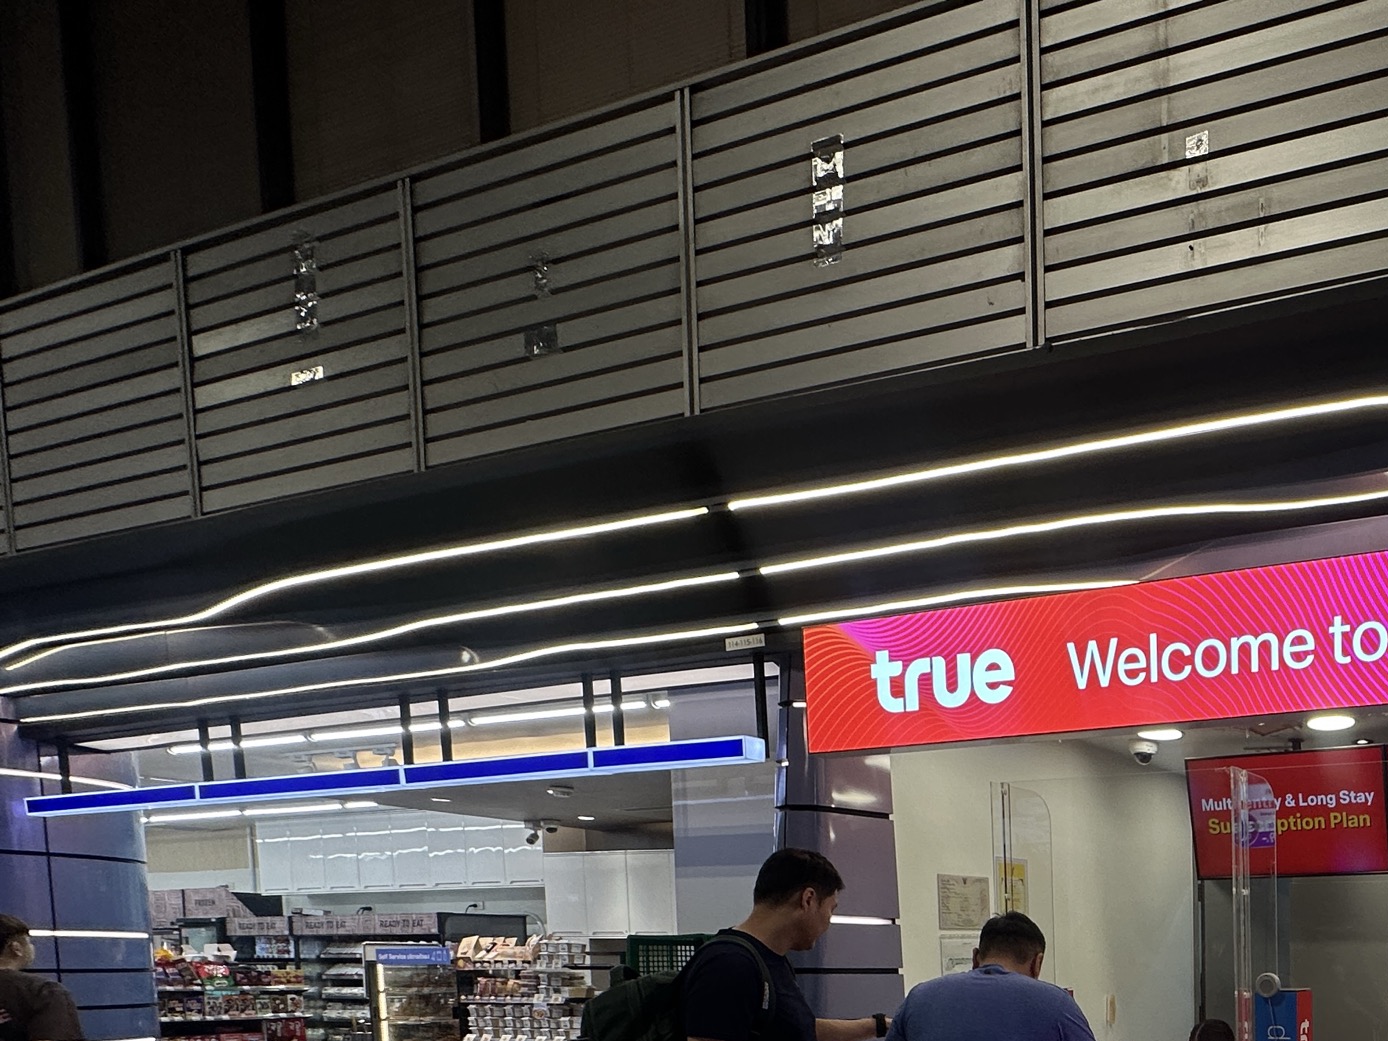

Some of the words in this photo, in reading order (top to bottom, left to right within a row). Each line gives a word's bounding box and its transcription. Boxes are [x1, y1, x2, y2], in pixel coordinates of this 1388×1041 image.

[1066, 628, 1315, 690] Welcome
[1328, 615, 1388, 665] to
[870, 648, 1015, 713] true
[1285, 793, 1295, 807] &
[1299, 793, 1336, 808] Long
[1339, 790, 1375, 805] Stay
[1330, 812, 1371, 828] Plan
[305, 921, 324, 929] READY
[326, 921, 333, 929] TO
[336, 920, 347, 929] EAT
[379, 919, 399, 927] READY
[401, 919, 409, 927] TO
[412, 918, 424, 927] EAT
